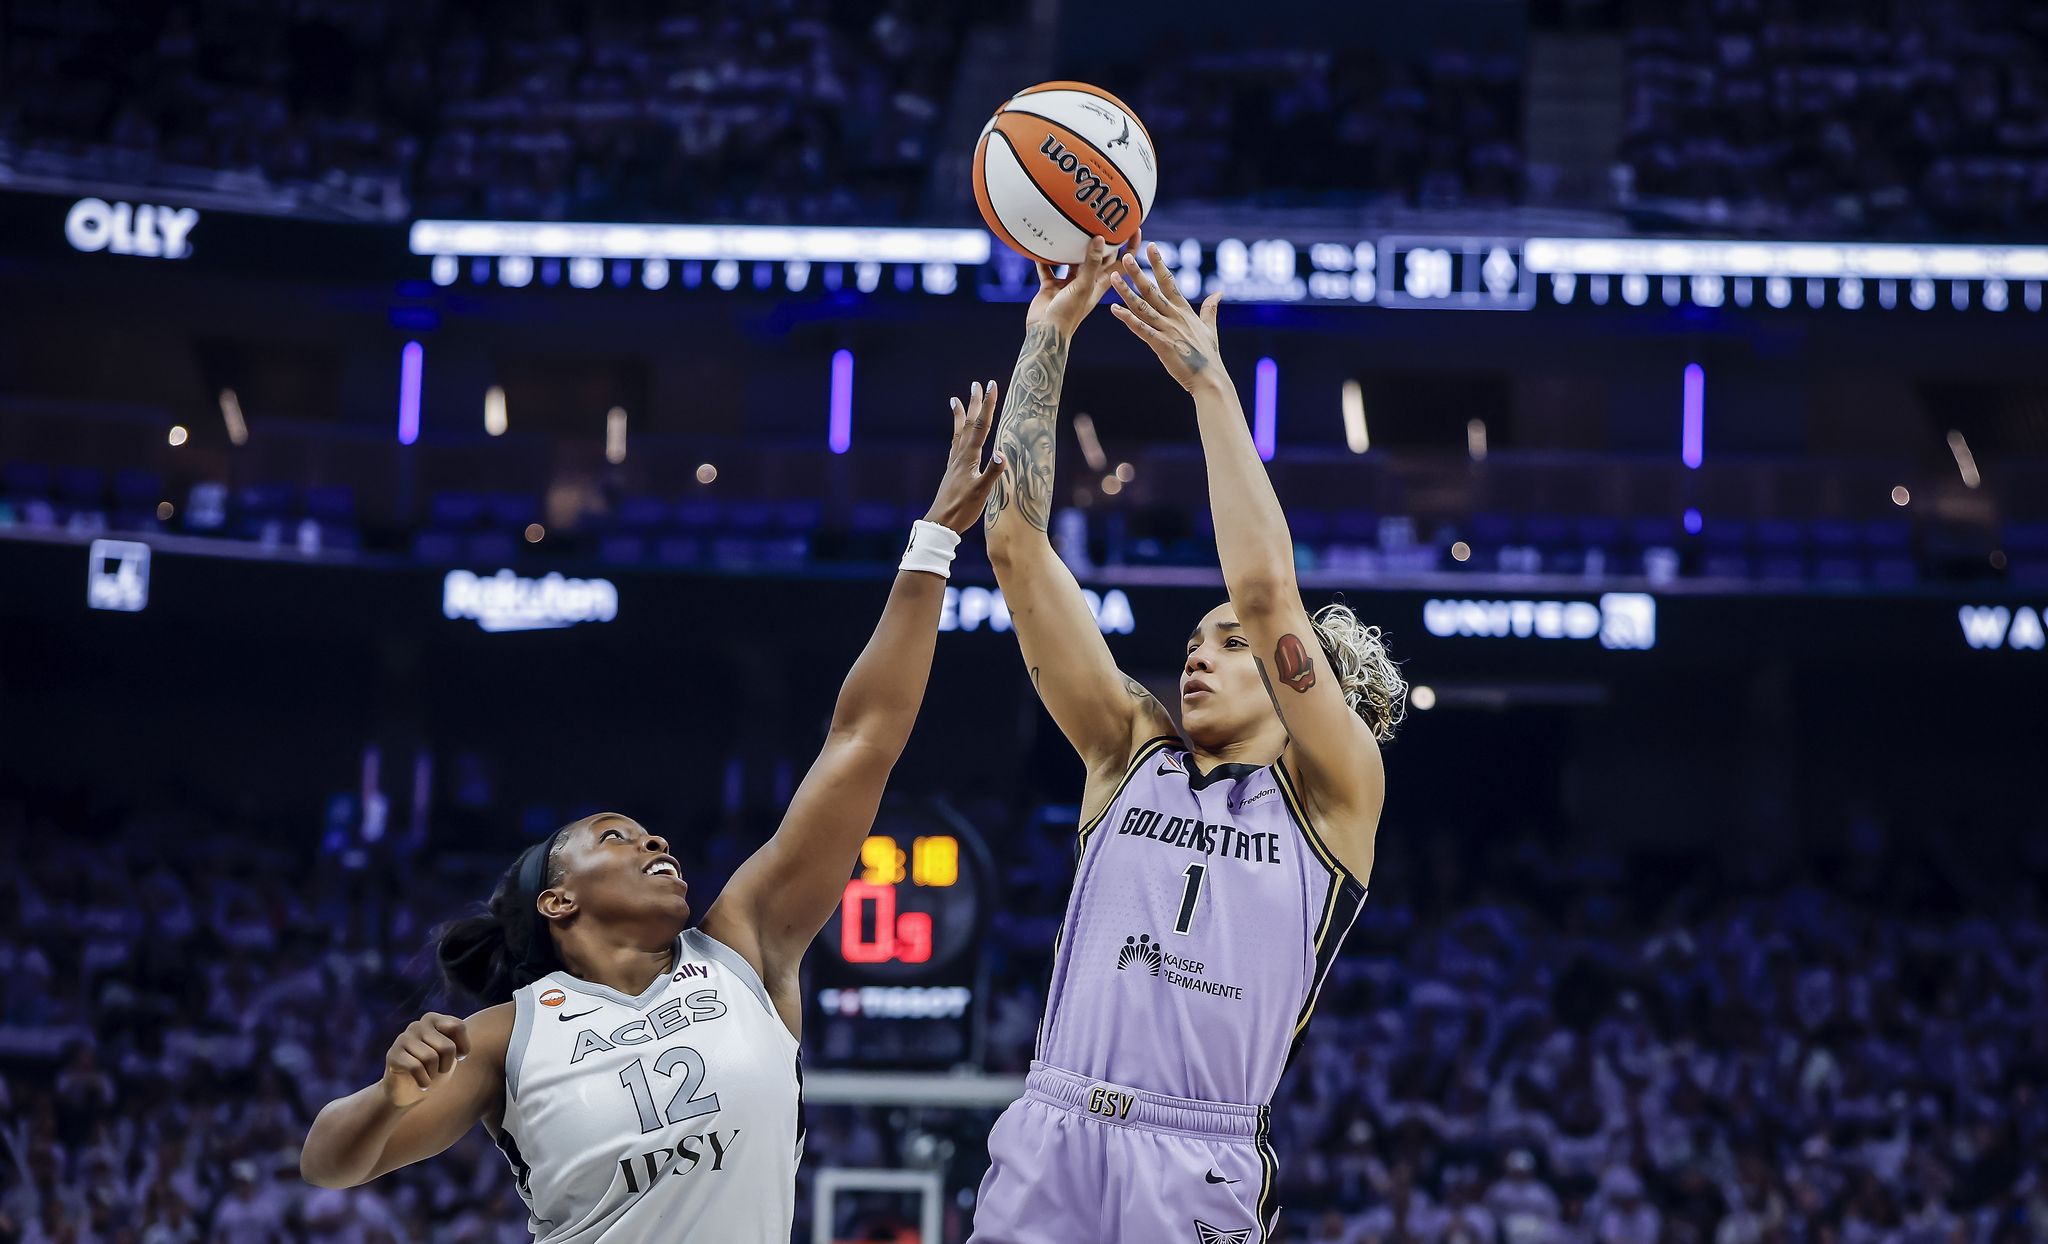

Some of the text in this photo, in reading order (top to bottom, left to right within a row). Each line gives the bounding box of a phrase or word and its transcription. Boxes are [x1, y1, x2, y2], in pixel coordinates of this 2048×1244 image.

[1039, 132, 1129, 235] Wilson
[64, 197, 199, 259] OLLY
[1959, 604, 2048, 650] WA
[1238, 788, 1276, 809] freedom
[1173, 862, 1207, 936] 1
[672, 963, 708, 983] ally
[1163, 952, 1205, 975] KAISER
[570, 989, 728, 1065] ACES
[619, 1046, 721, 1135] 12
[1088, 1087, 1135, 1120] GSV
[618, 1129, 741, 1194] IPSY
